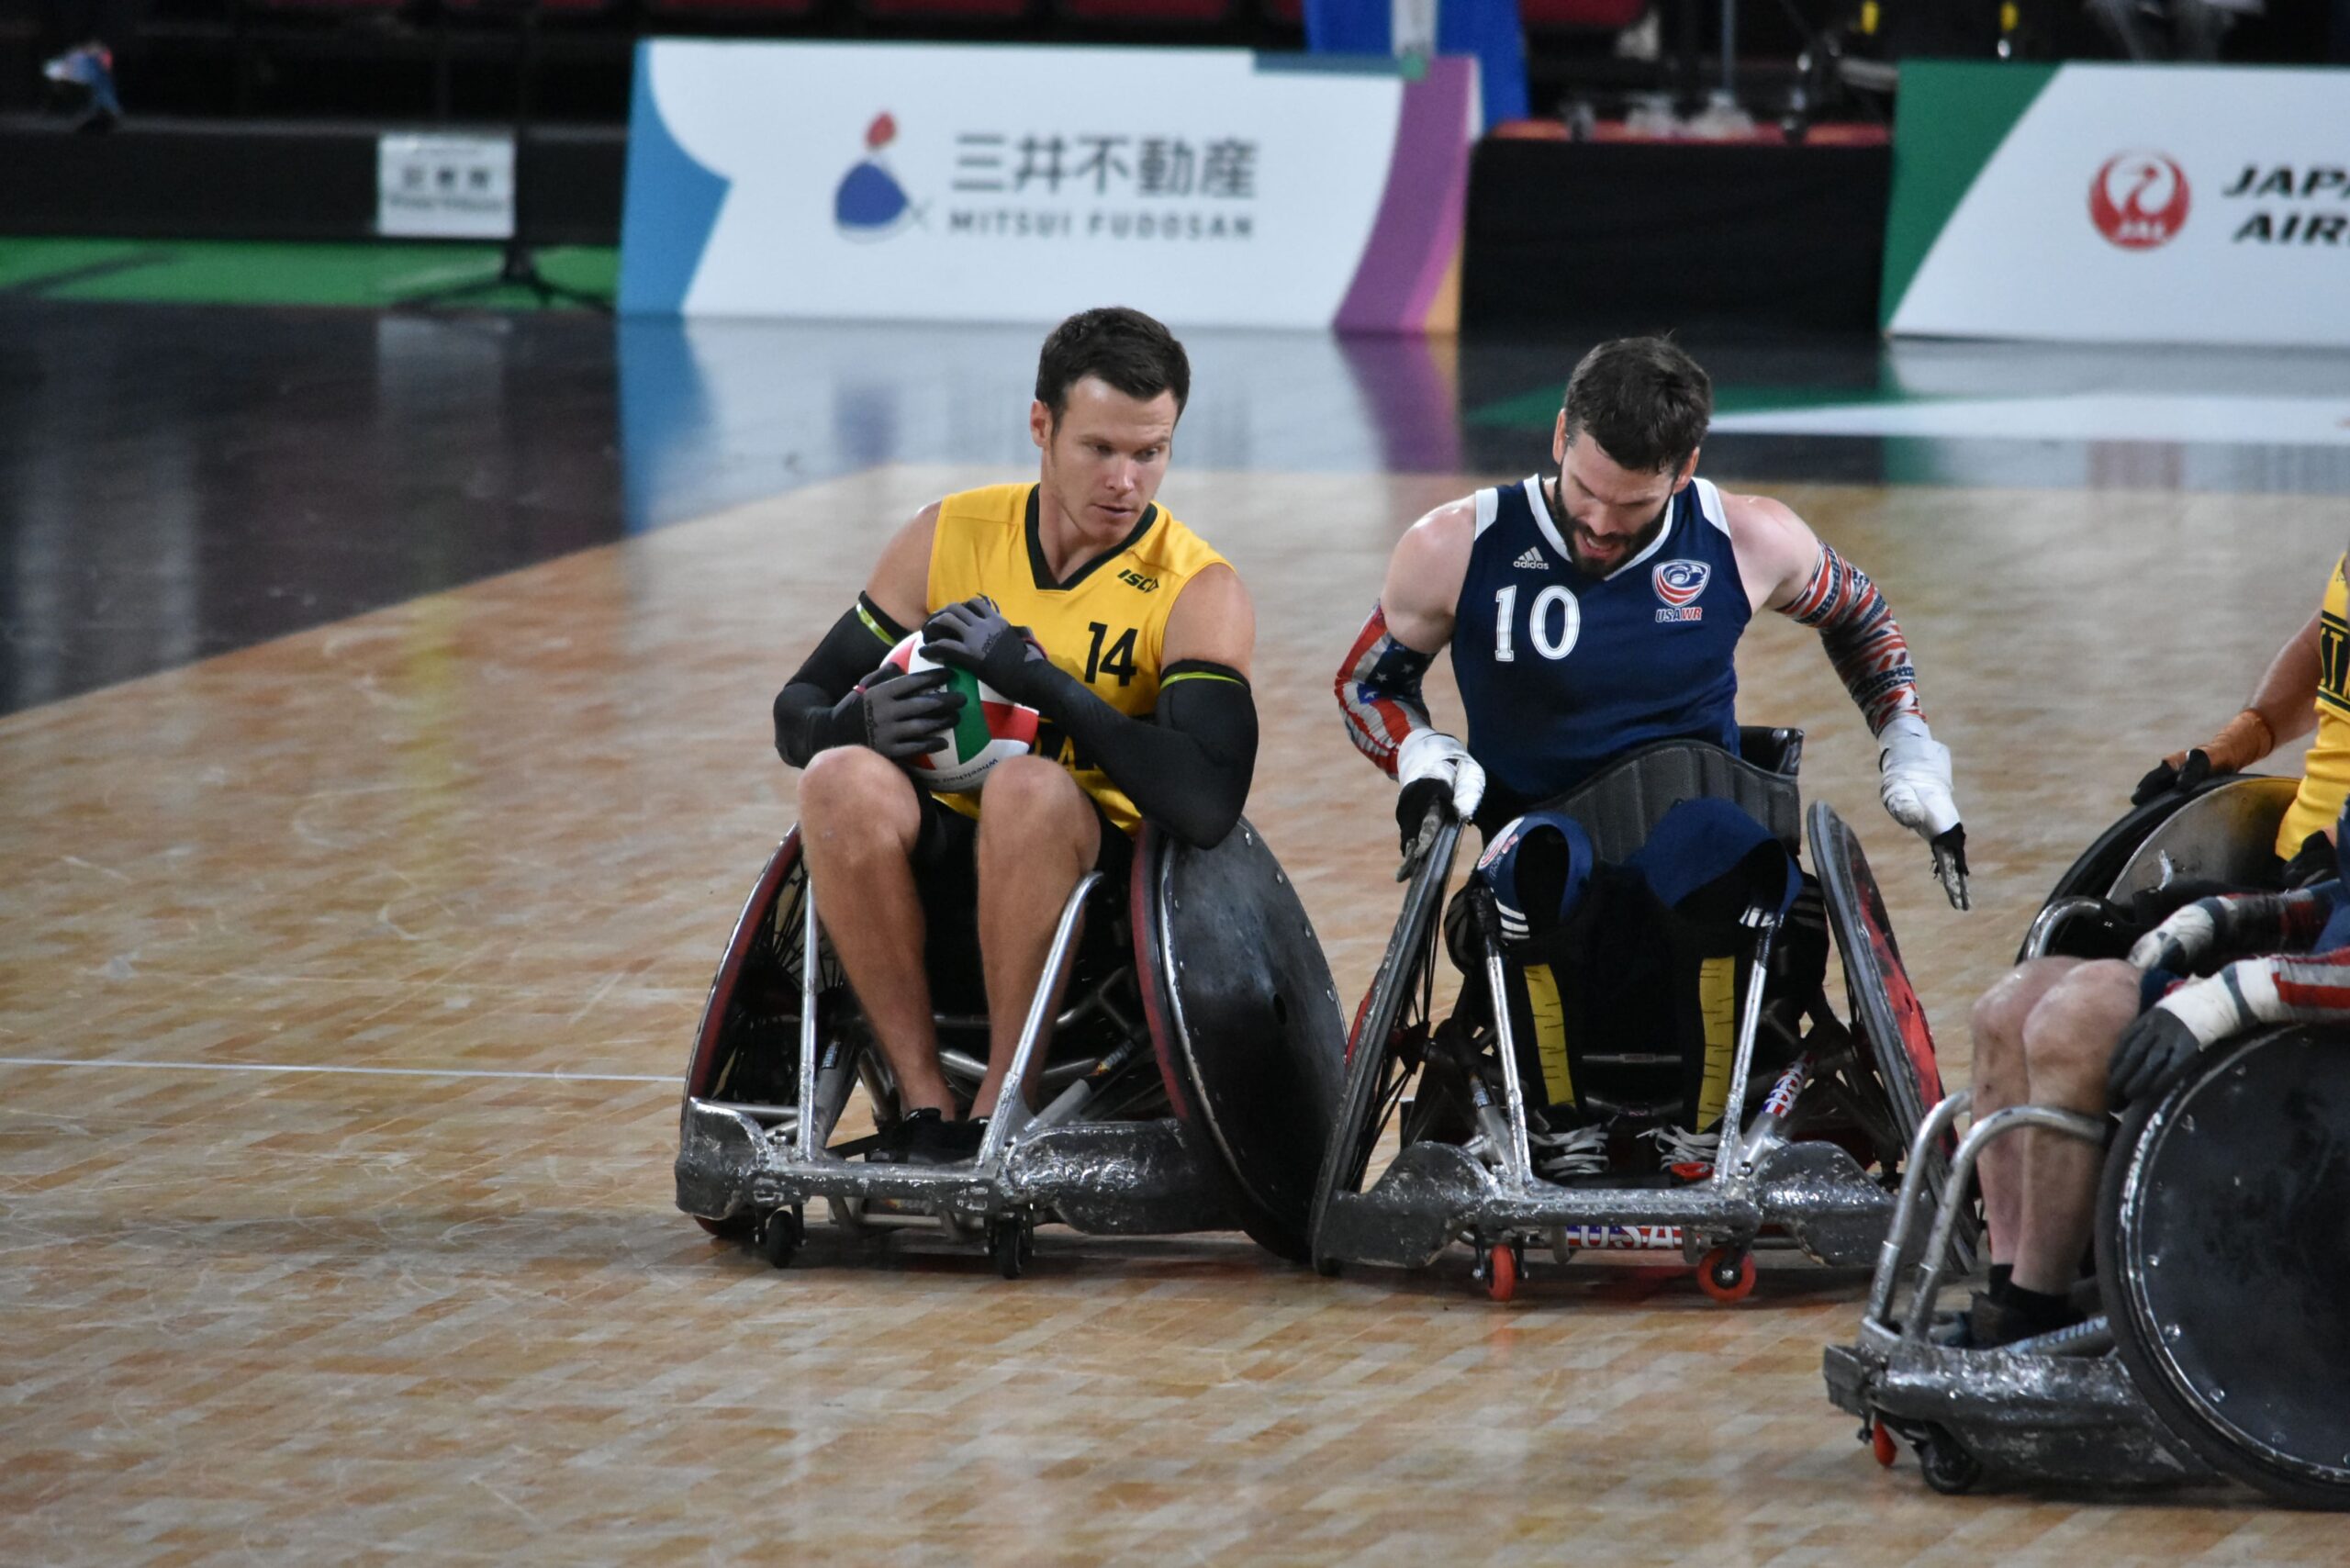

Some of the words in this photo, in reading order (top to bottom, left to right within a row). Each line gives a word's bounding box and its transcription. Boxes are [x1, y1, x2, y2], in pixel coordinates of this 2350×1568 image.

[951, 136, 1258, 198] 三井不動産
[2221, 163, 2350, 198] JAP
[949, 212, 1070, 237] MITSUI
[1090, 213, 1252, 240] FUDOSAN
[1513, 559, 1550, 570] adidas
[1494, 584, 1581, 662] 10
[1655, 607, 1702, 622] USAWR
[1084, 622, 1138, 687] 14
[1580, 1225, 1674, 1249] USA
